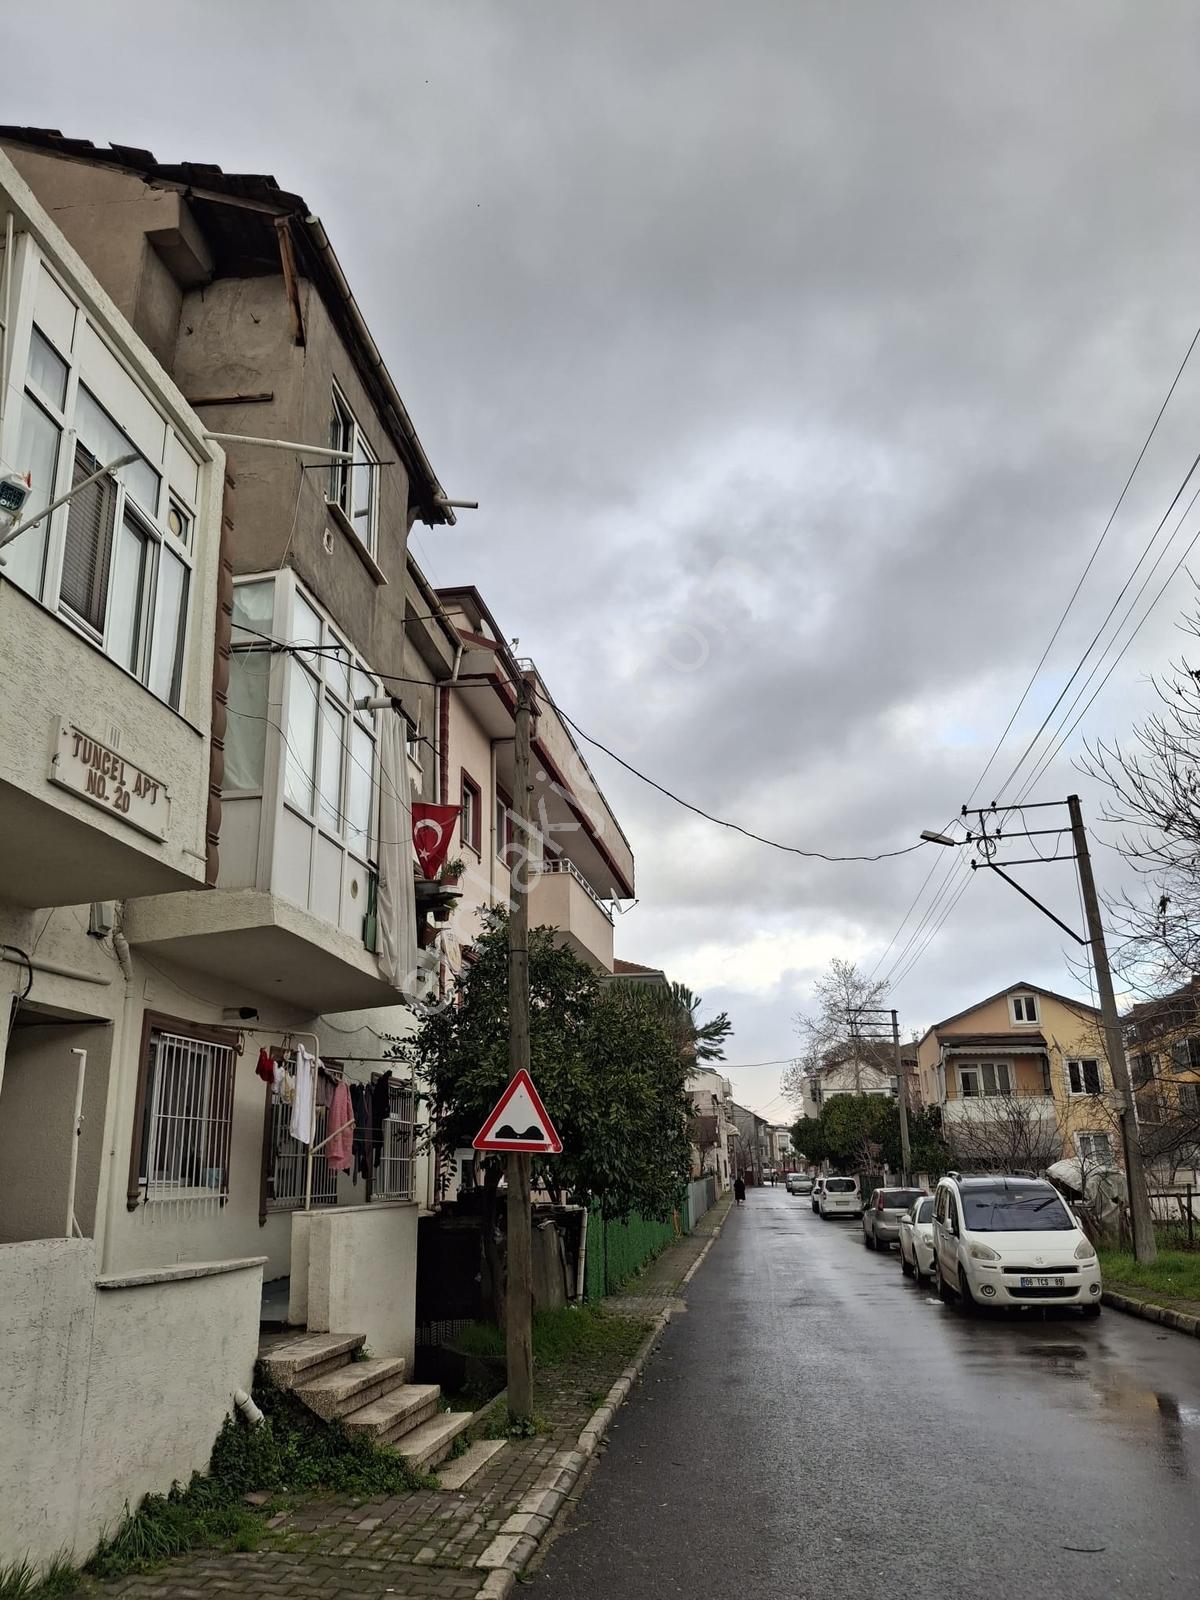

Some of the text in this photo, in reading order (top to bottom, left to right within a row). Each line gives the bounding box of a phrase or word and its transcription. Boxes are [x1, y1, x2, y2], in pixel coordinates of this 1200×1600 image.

[72, 732, 160, 805] TUNCEL APT
[85, 768, 131, 814] NO. 20
